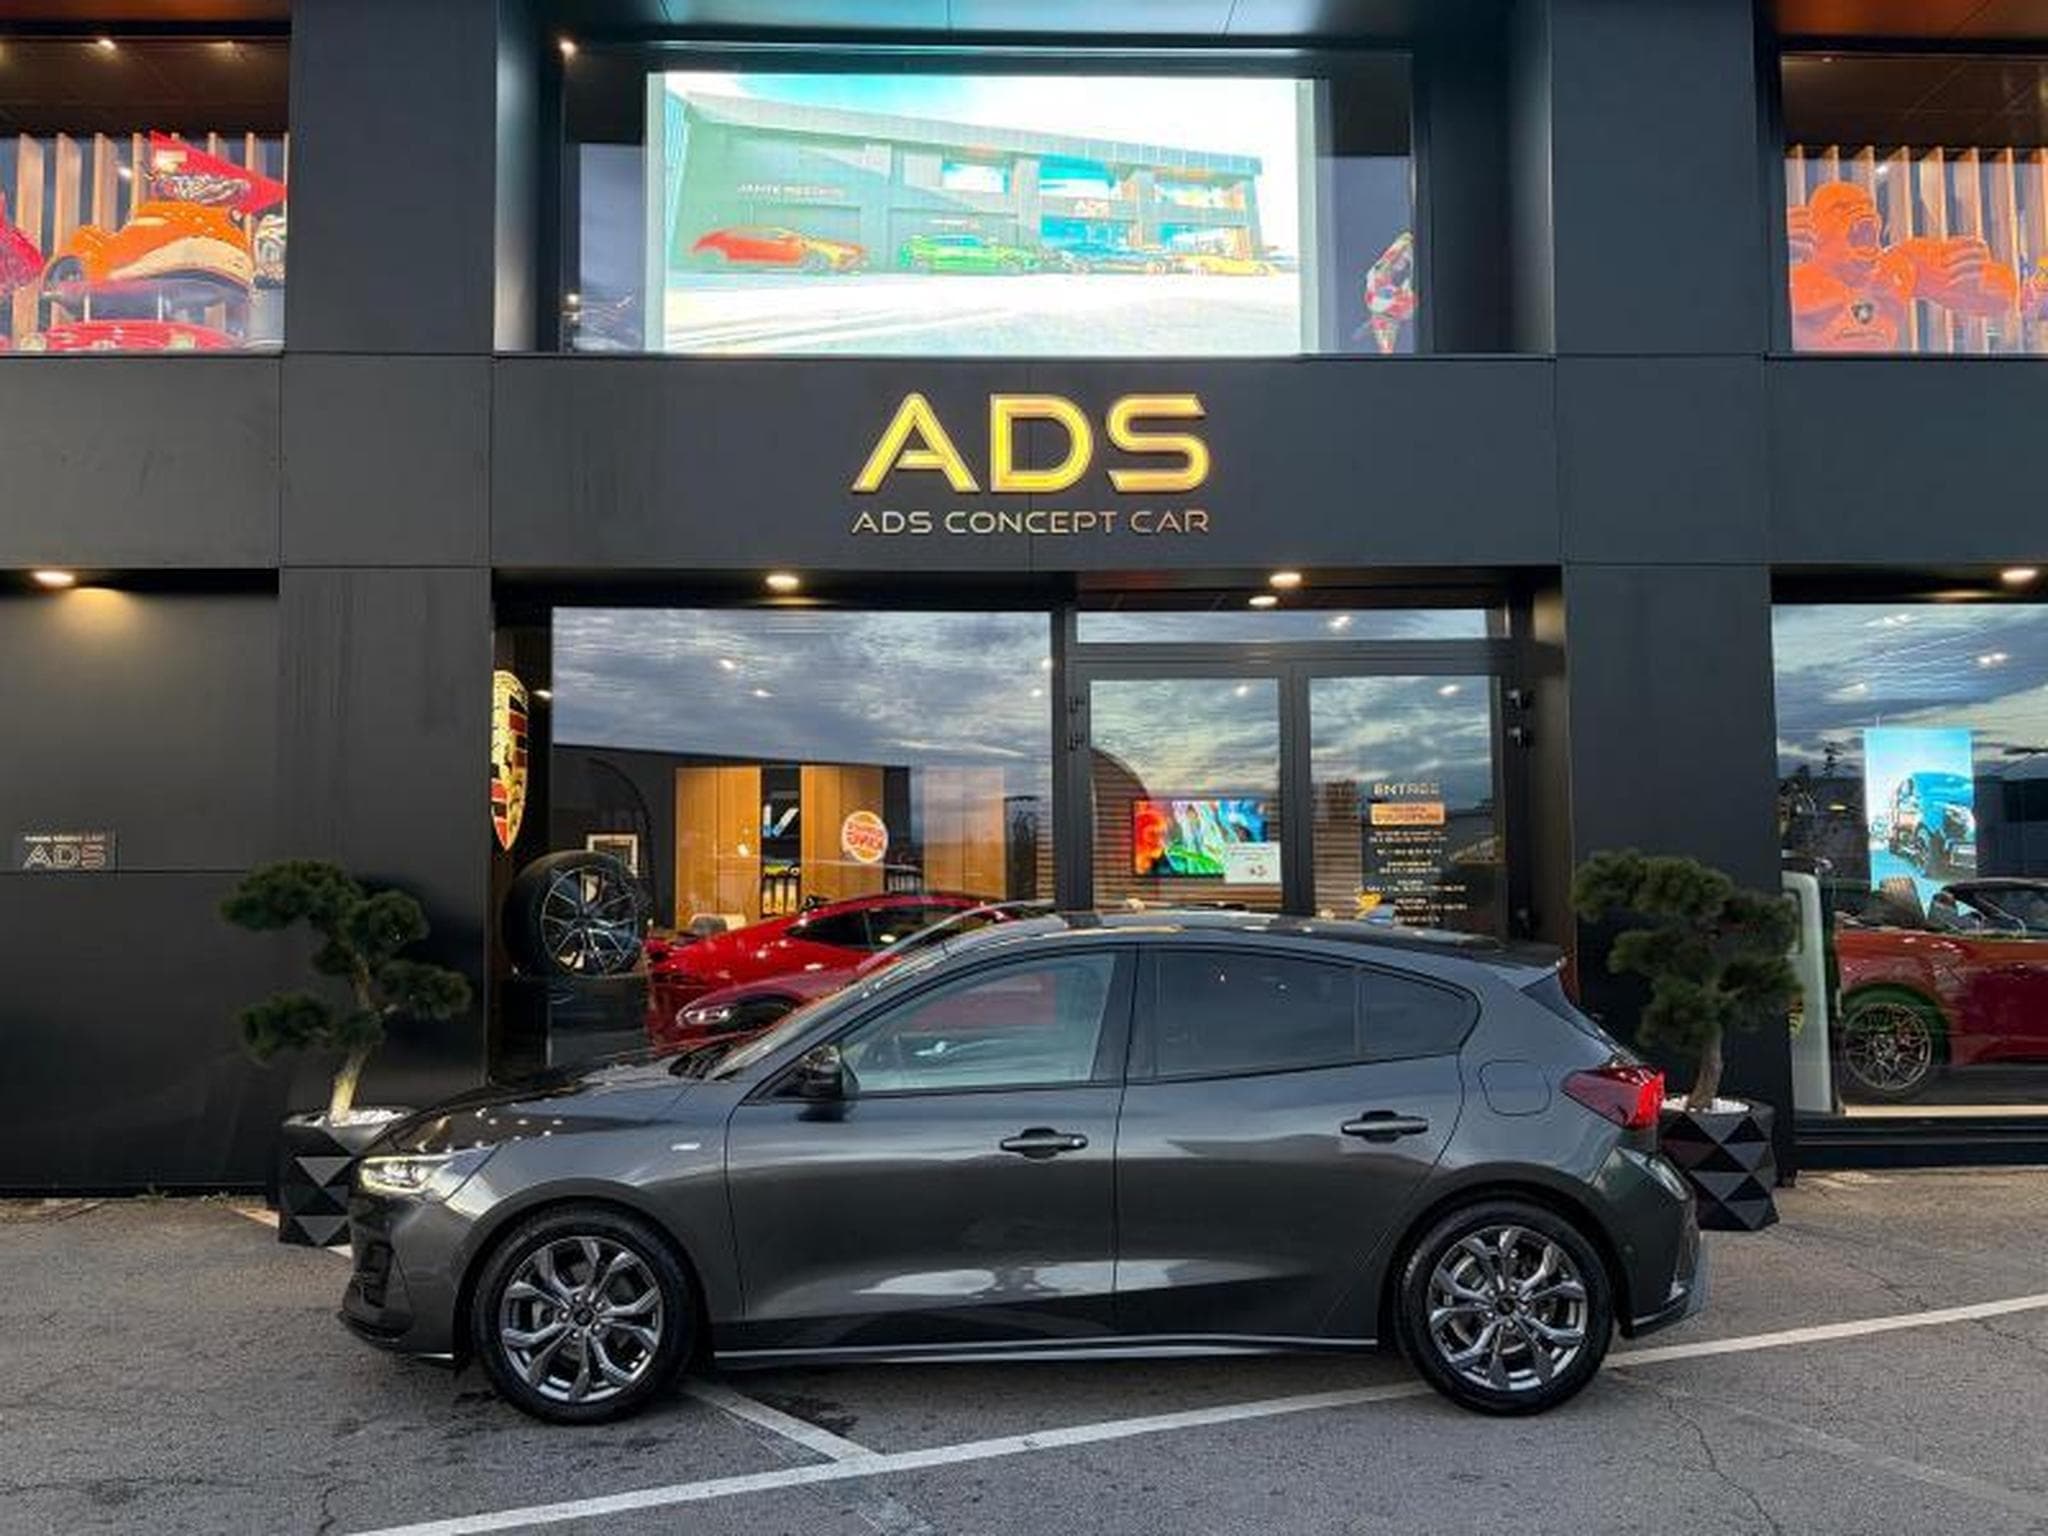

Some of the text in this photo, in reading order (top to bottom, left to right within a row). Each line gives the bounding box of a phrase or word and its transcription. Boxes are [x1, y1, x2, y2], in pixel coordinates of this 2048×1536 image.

[850, 392, 1211, 494] ADS
[851, 510, 1210, 534] ADS CONCEPT CAR
[22, 844, 106, 870] ADS
